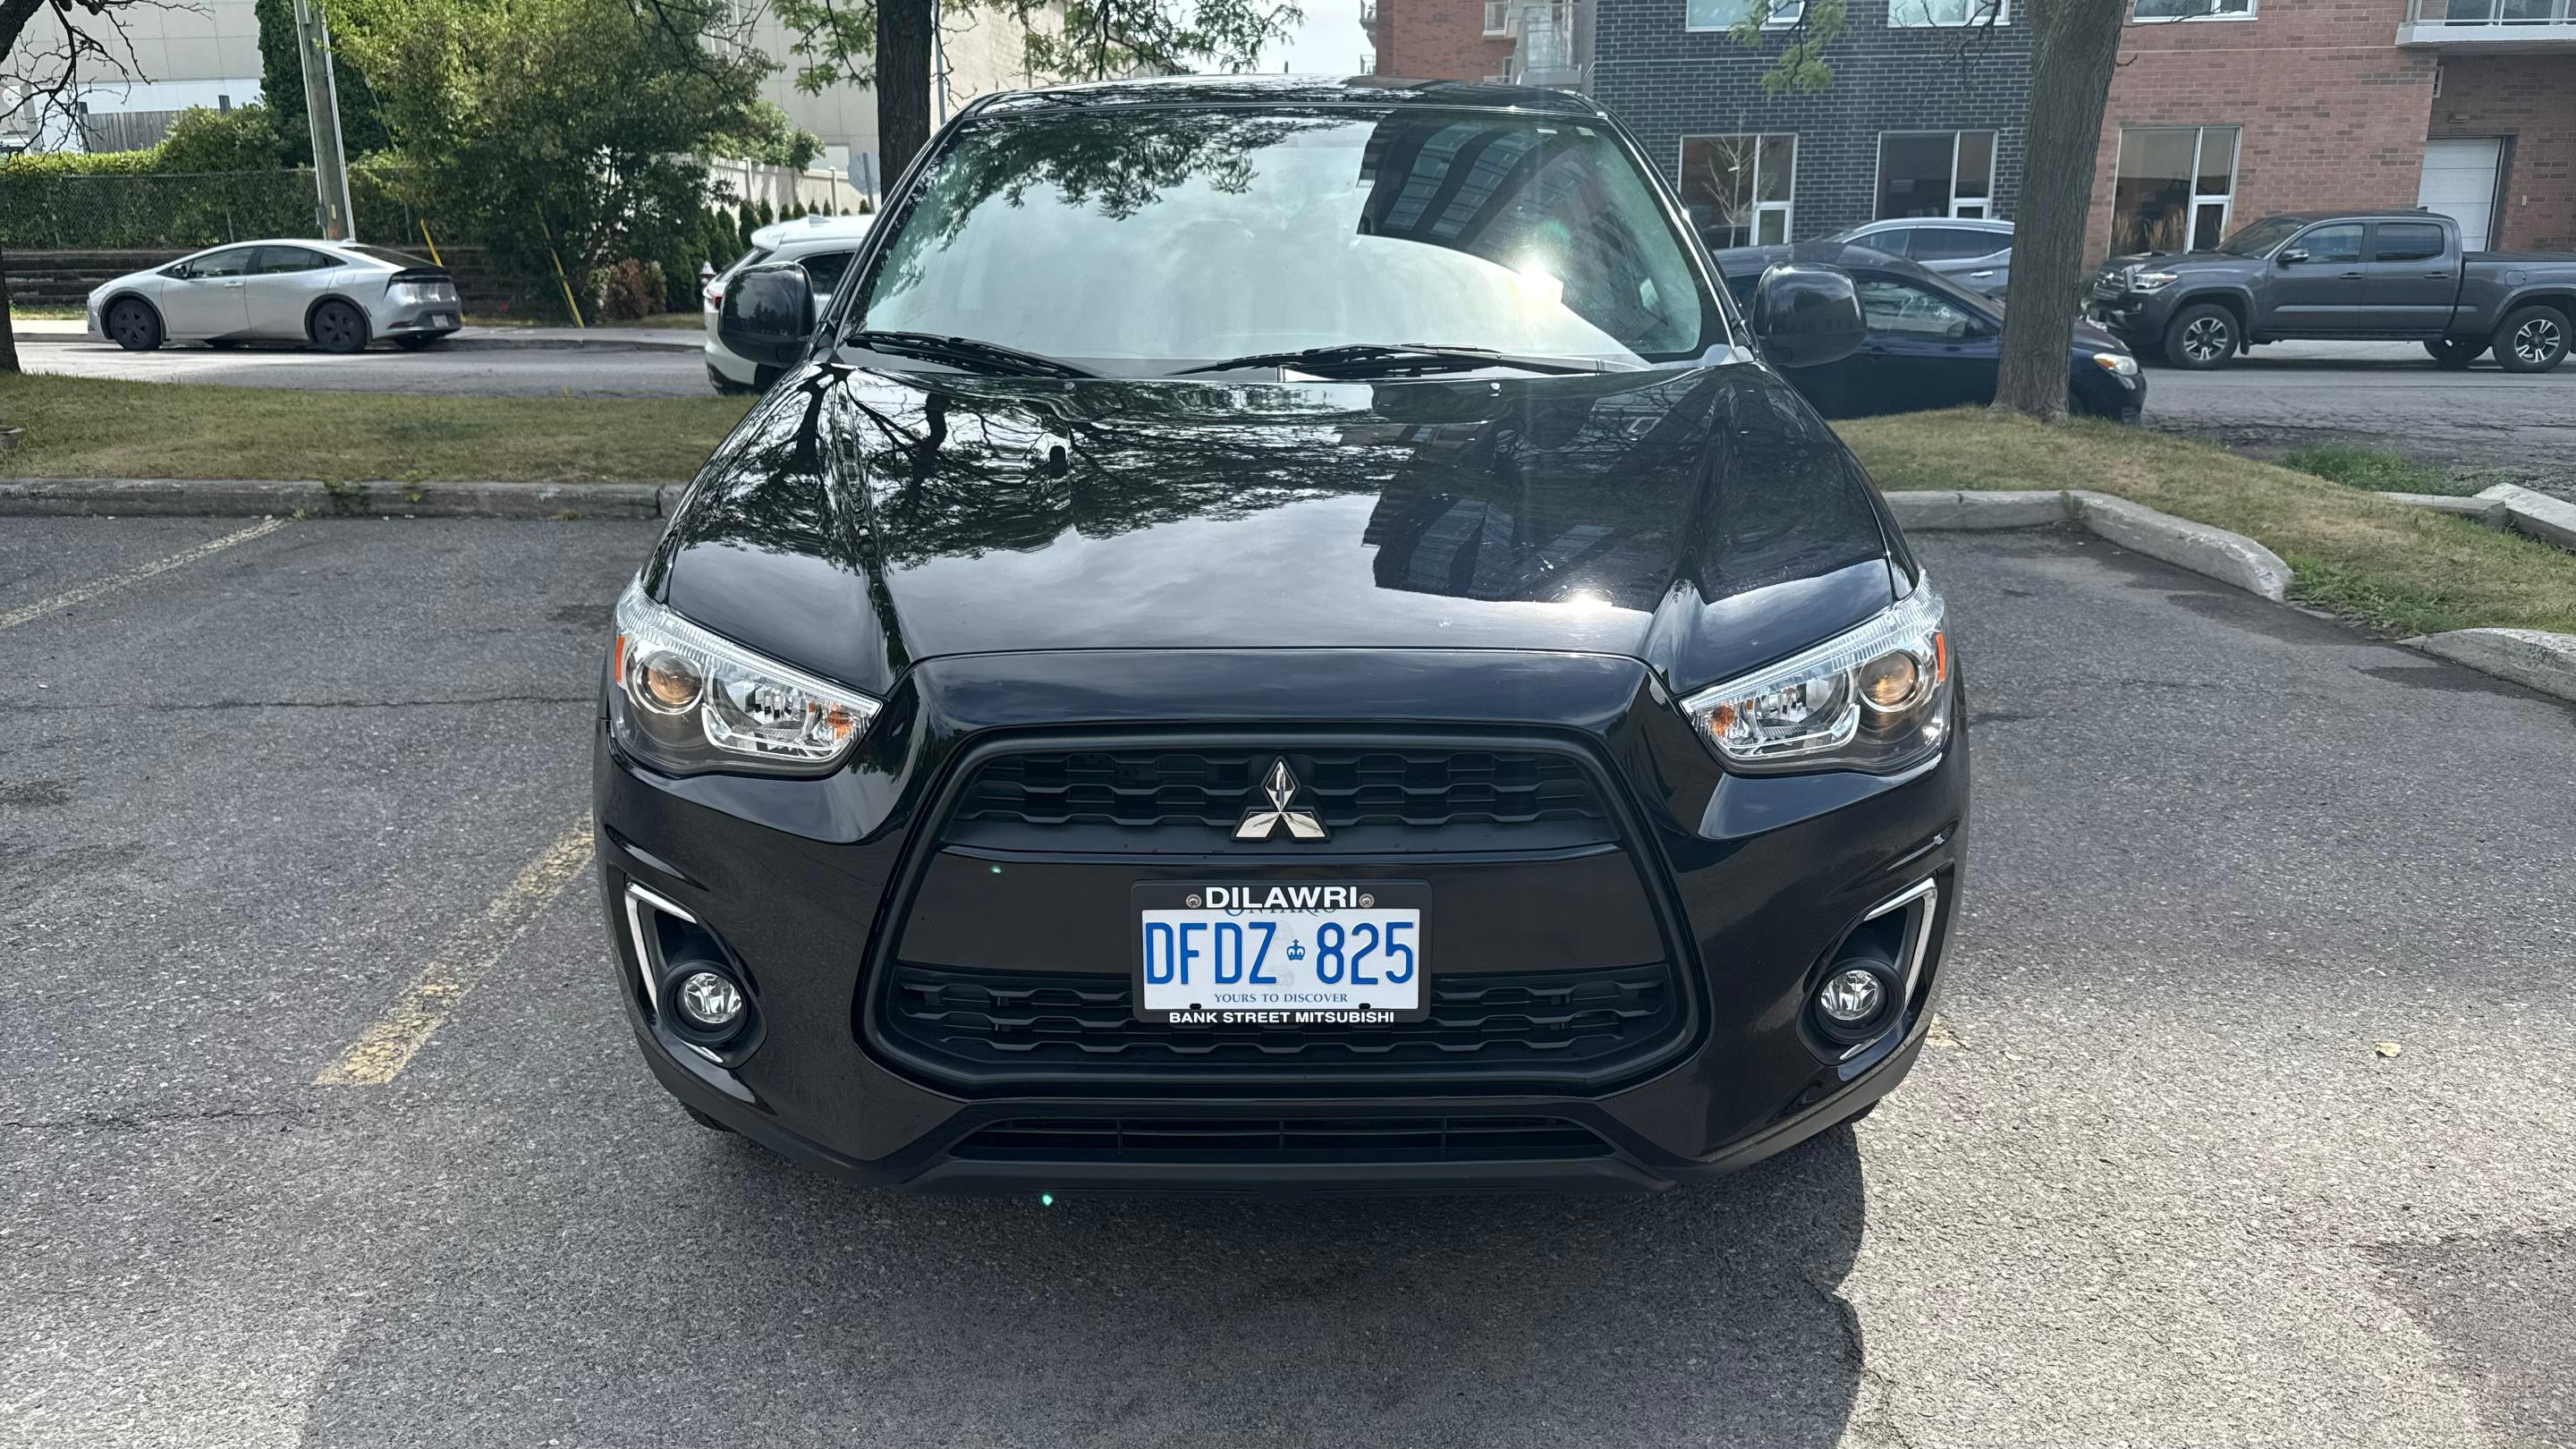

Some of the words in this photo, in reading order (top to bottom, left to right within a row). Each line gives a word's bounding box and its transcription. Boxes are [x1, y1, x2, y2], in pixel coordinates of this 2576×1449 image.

[1206, 886, 1357, 909] DILAWRI
[1145, 921, 1277, 986] DFDZ
[1316, 921, 1414, 985] 825
[1214, 993, 1257, 1003] YOURS
[1261, 993, 1279, 1003] TO
[1284, 993, 1348, 1003] DISCOVER
[1169, 1012, 1218, 1023] BANK
[1222, 1012, 1291, 1023] STREET
[1295, 1012, 1394, 1023] MITSUBISHI
